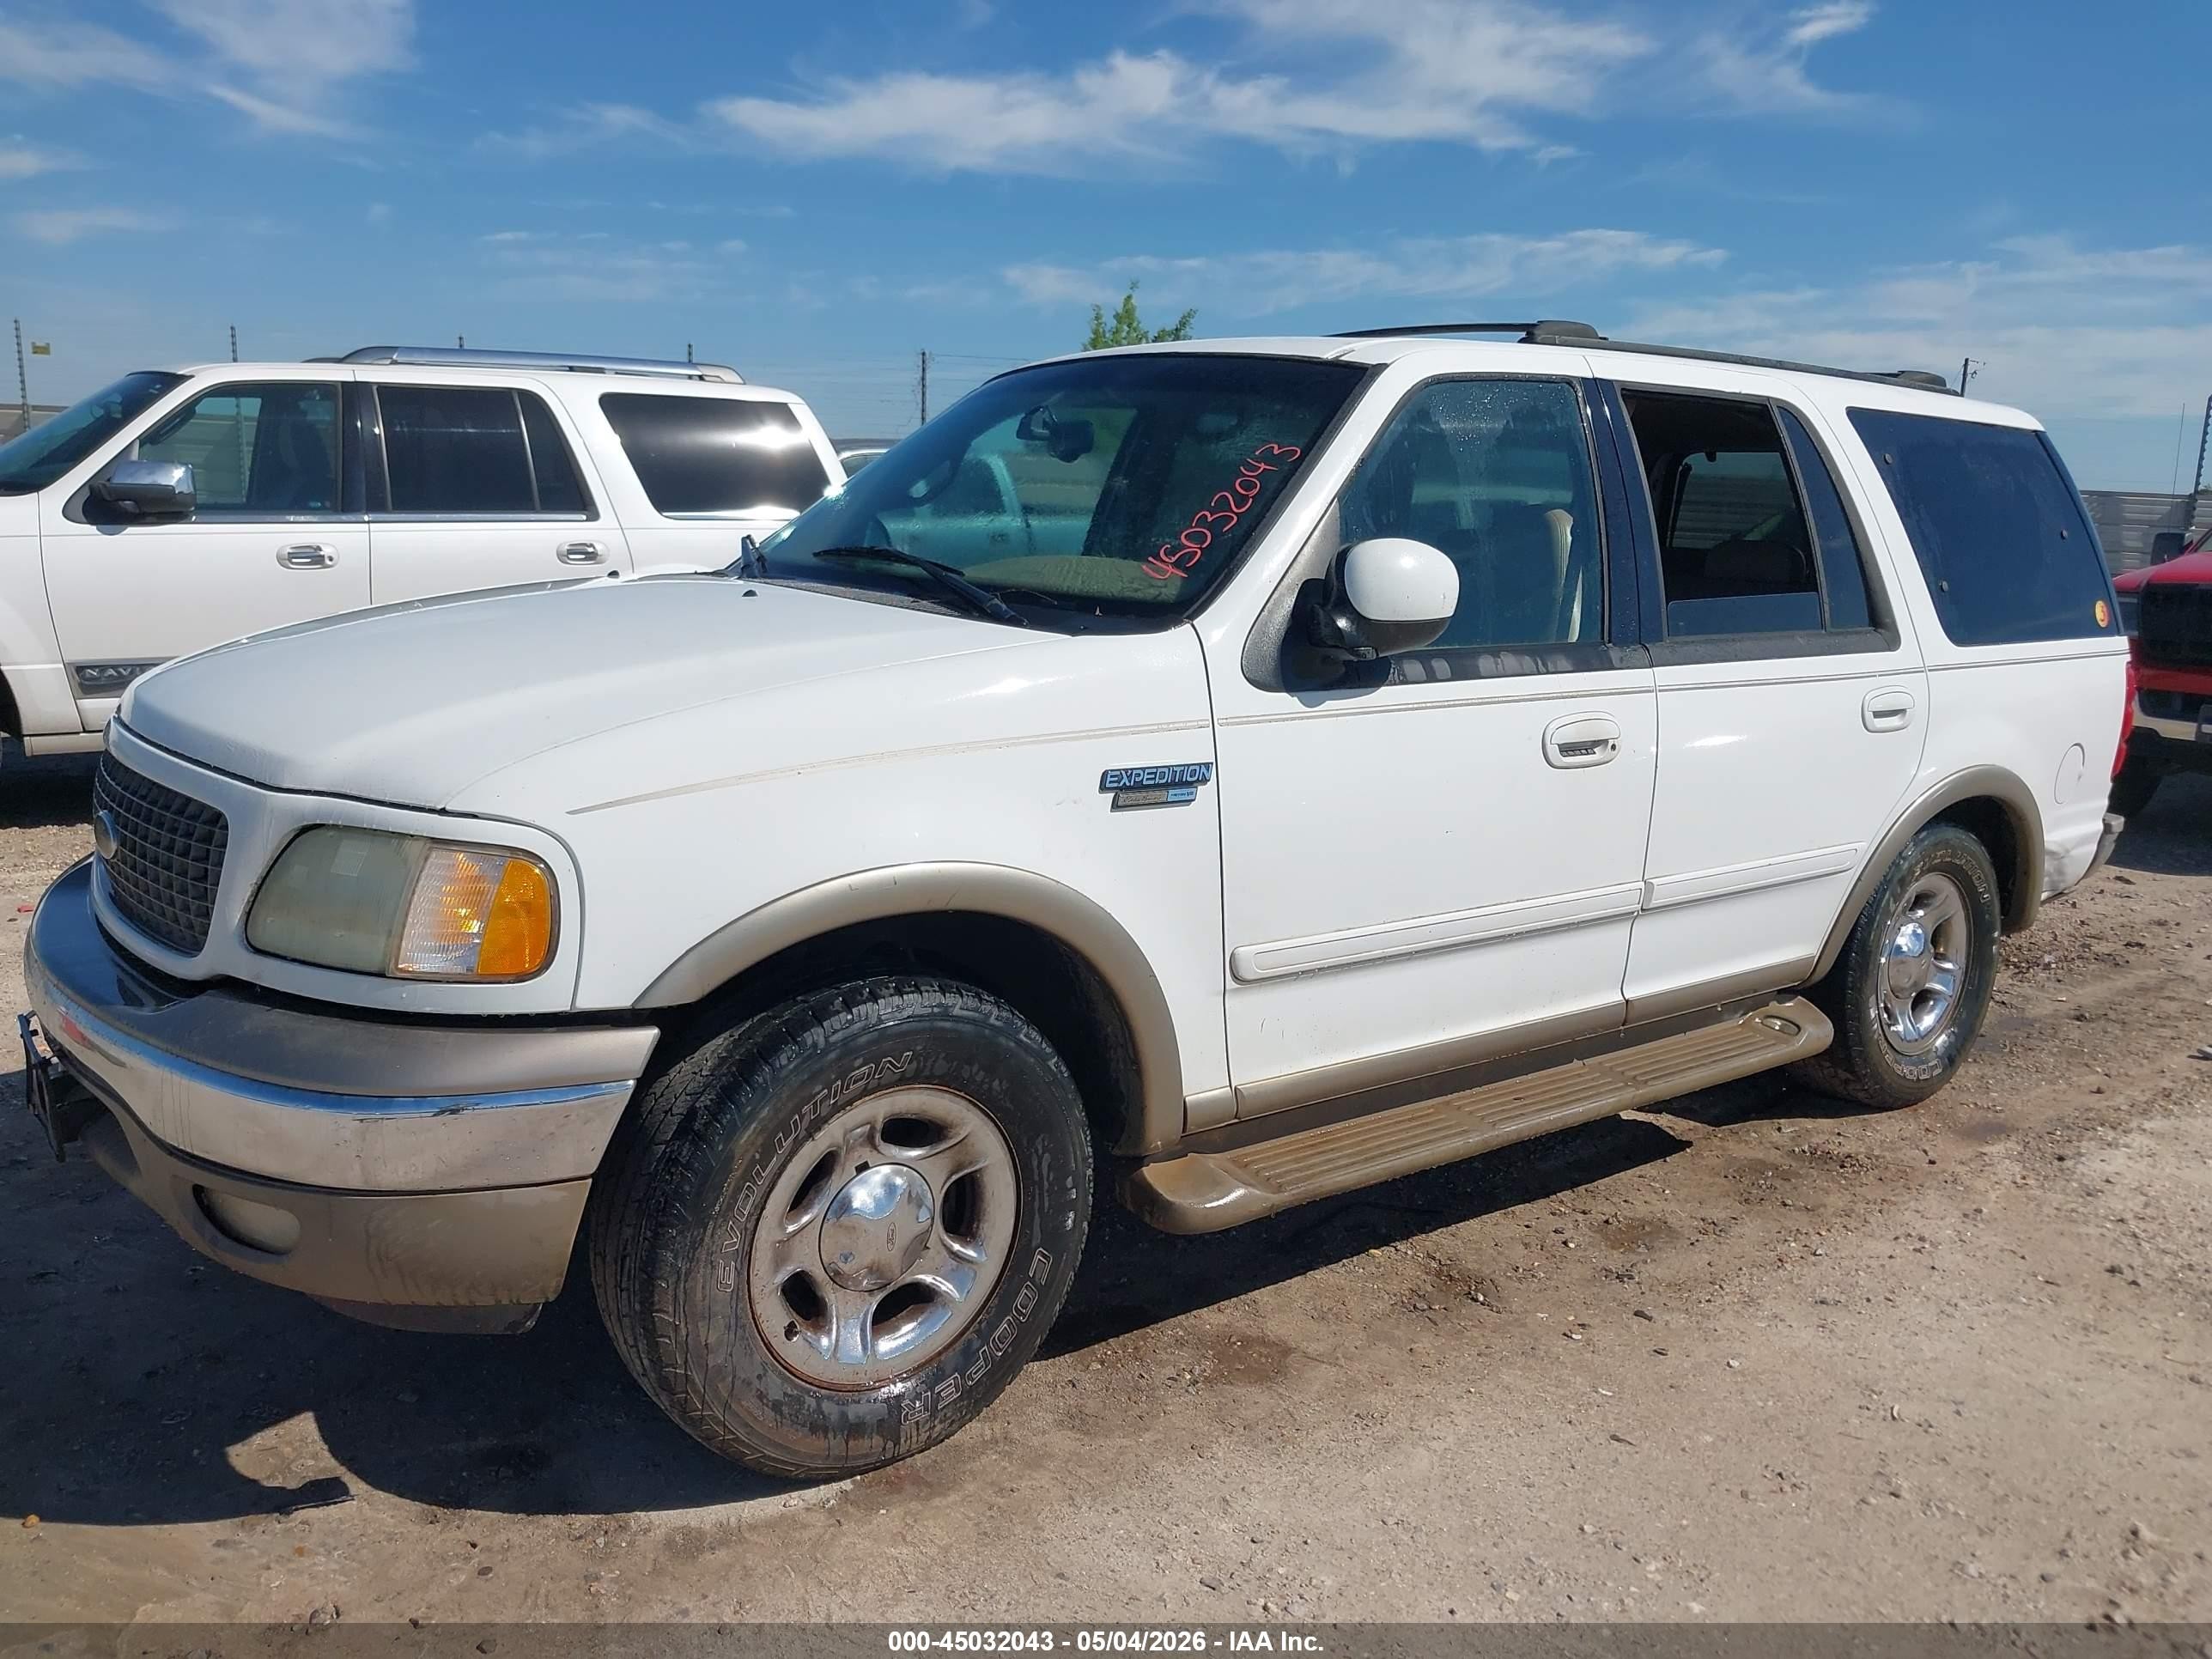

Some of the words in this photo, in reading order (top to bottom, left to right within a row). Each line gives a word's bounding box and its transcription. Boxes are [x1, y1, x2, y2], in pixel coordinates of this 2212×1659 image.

[1141, 444, 1301, 579] 45032043
[83, 666, 153, 678] NAVI
[1105, 764, 1212, 787] EXPEDITION
[717, 1051, 913, 1292] EVOLUTION
[901, 1247, 1053, 1425] COOPER
